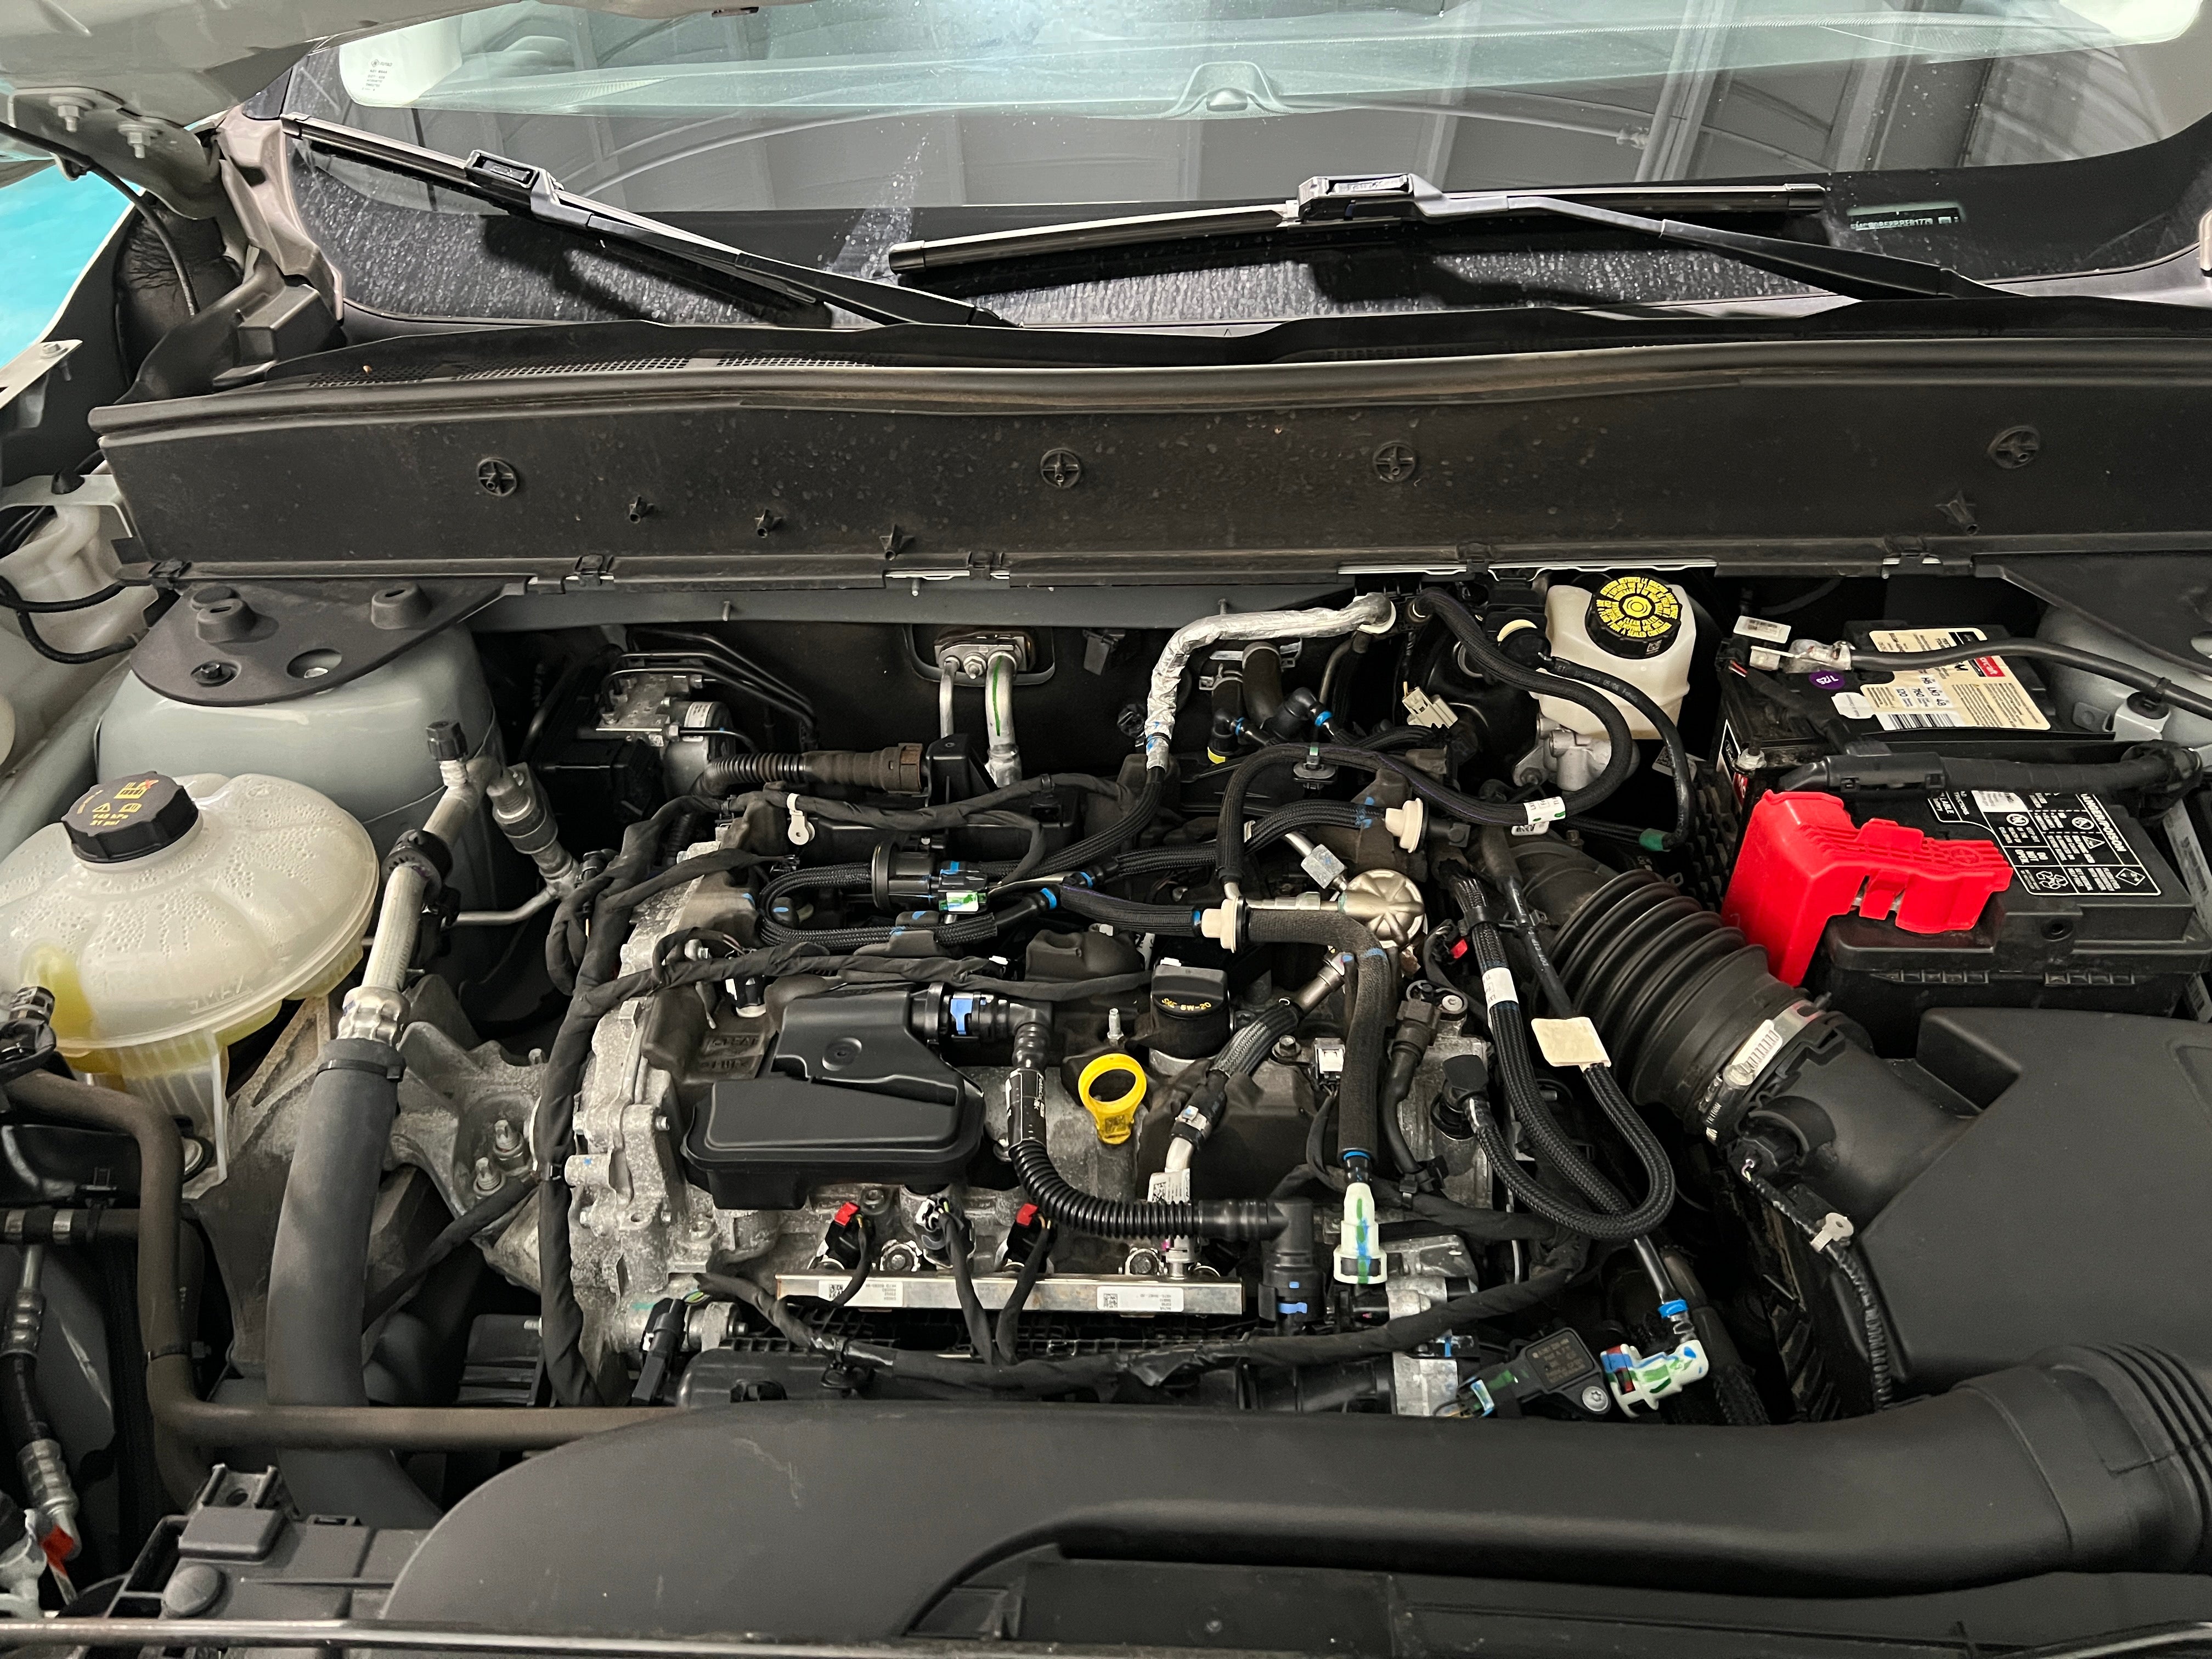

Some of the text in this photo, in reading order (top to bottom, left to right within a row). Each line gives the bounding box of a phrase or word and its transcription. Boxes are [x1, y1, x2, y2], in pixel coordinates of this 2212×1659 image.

[1979, 657, 1999, 675] orcraft
[2015, 850, 2029, 864] OPEN.
[2026, 851, 2039, 861] NOT
[1161, 998, 1211, 1011] SAE 5W-20
